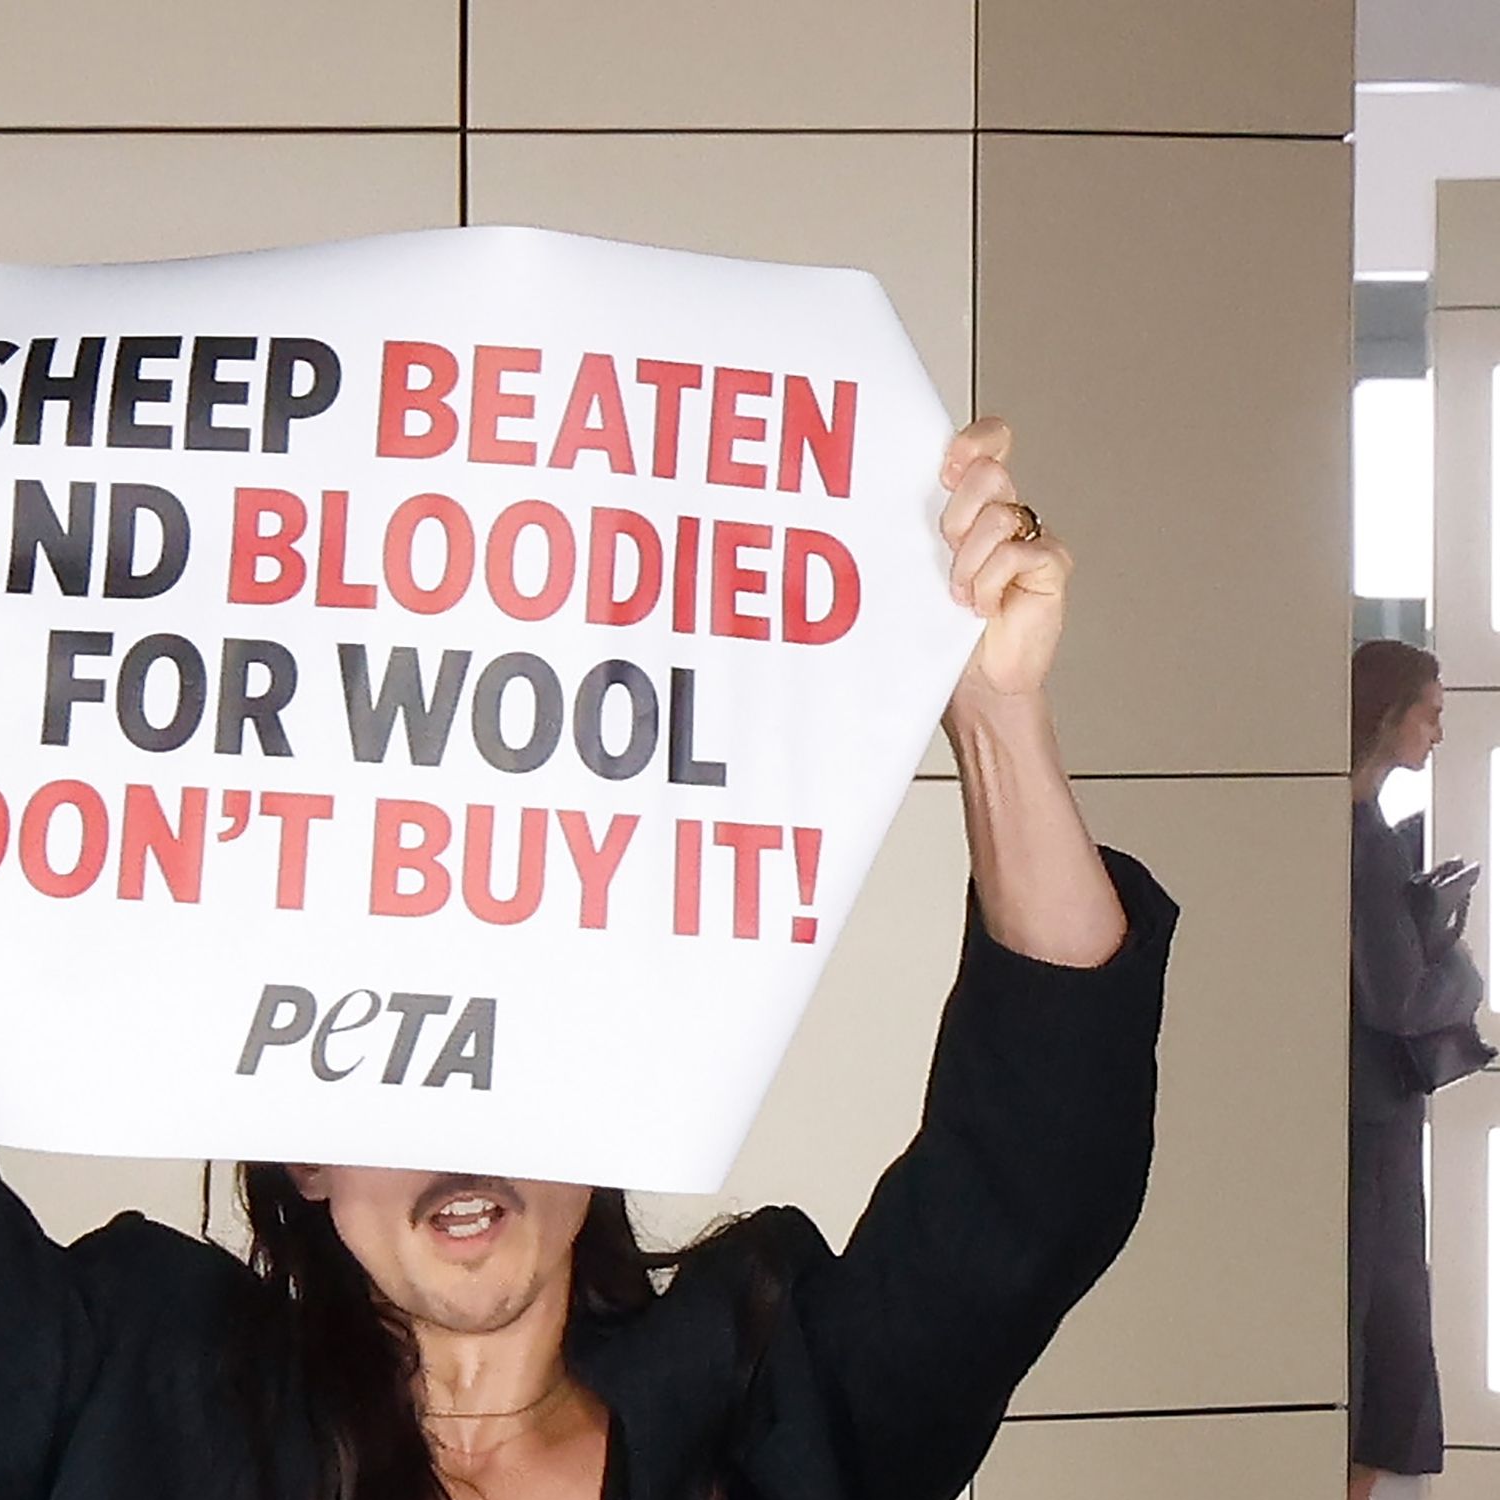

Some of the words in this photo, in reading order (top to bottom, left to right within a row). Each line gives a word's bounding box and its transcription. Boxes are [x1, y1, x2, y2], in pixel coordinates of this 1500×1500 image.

[376, 341, 857, 498] BEATEN
[228, 488, 860, 645] BLOODIED
[41, 630, 298, 757] FOR
[337, 643, 726, 787] WOOL
[371, 799, 640, 929] BUY
[674, 820, 822, 944] IT!
